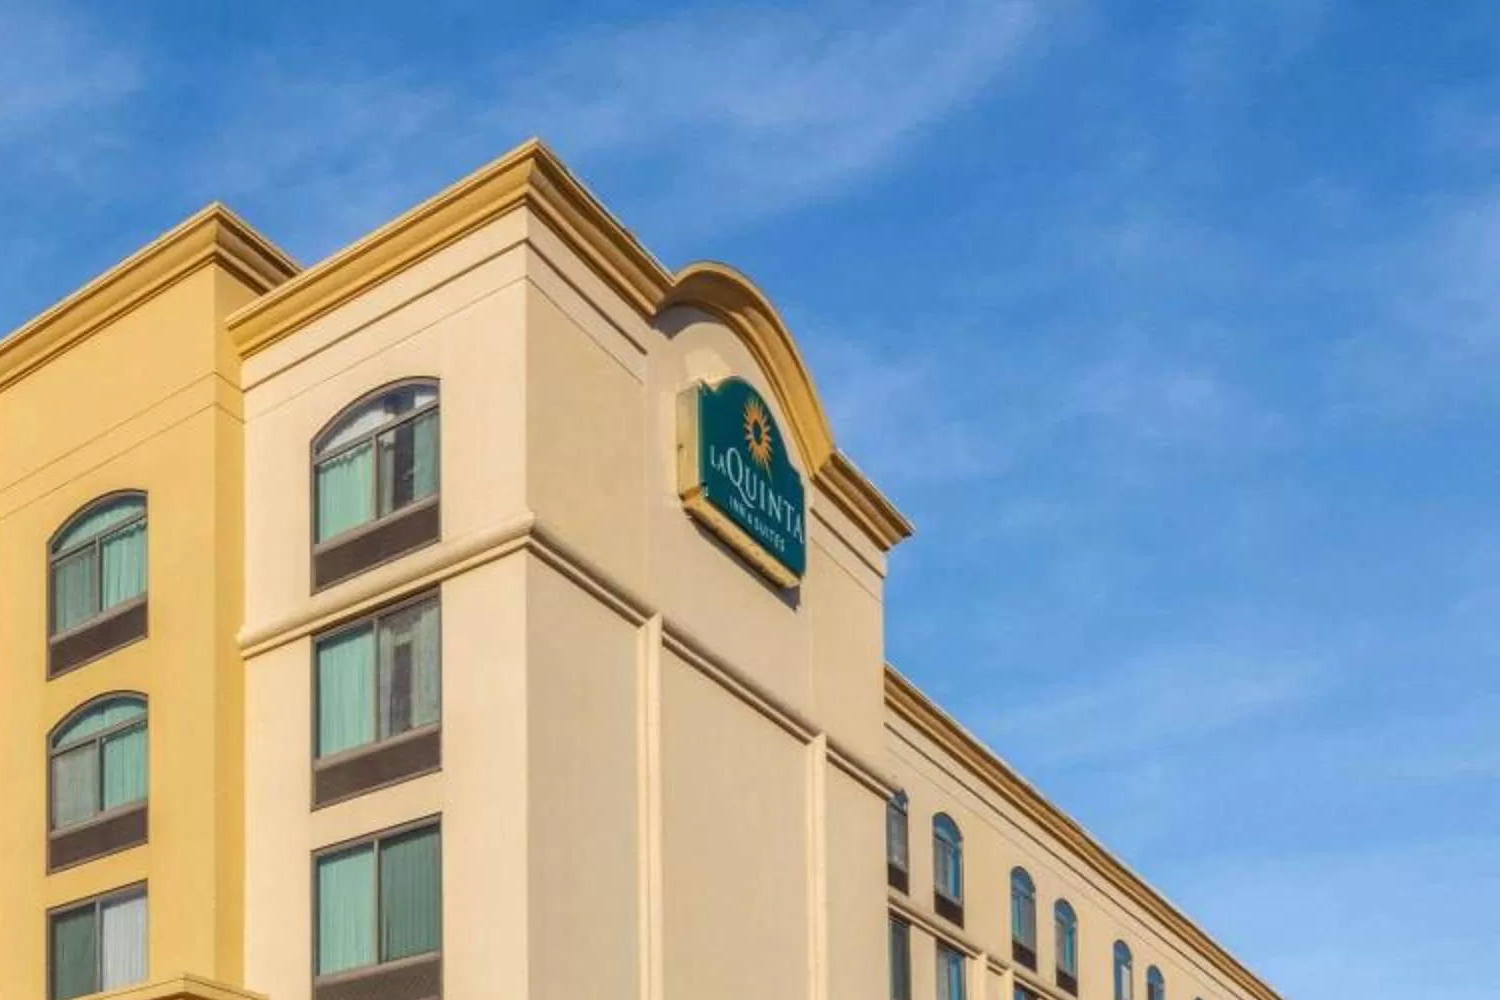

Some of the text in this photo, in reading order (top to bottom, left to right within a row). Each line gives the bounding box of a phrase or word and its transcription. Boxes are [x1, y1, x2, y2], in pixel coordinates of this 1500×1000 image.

[710, 445, 805, 545] LA QUINTA
[729, 495, 745, 518] INN
[754, 518, 786, 553] SUITES
